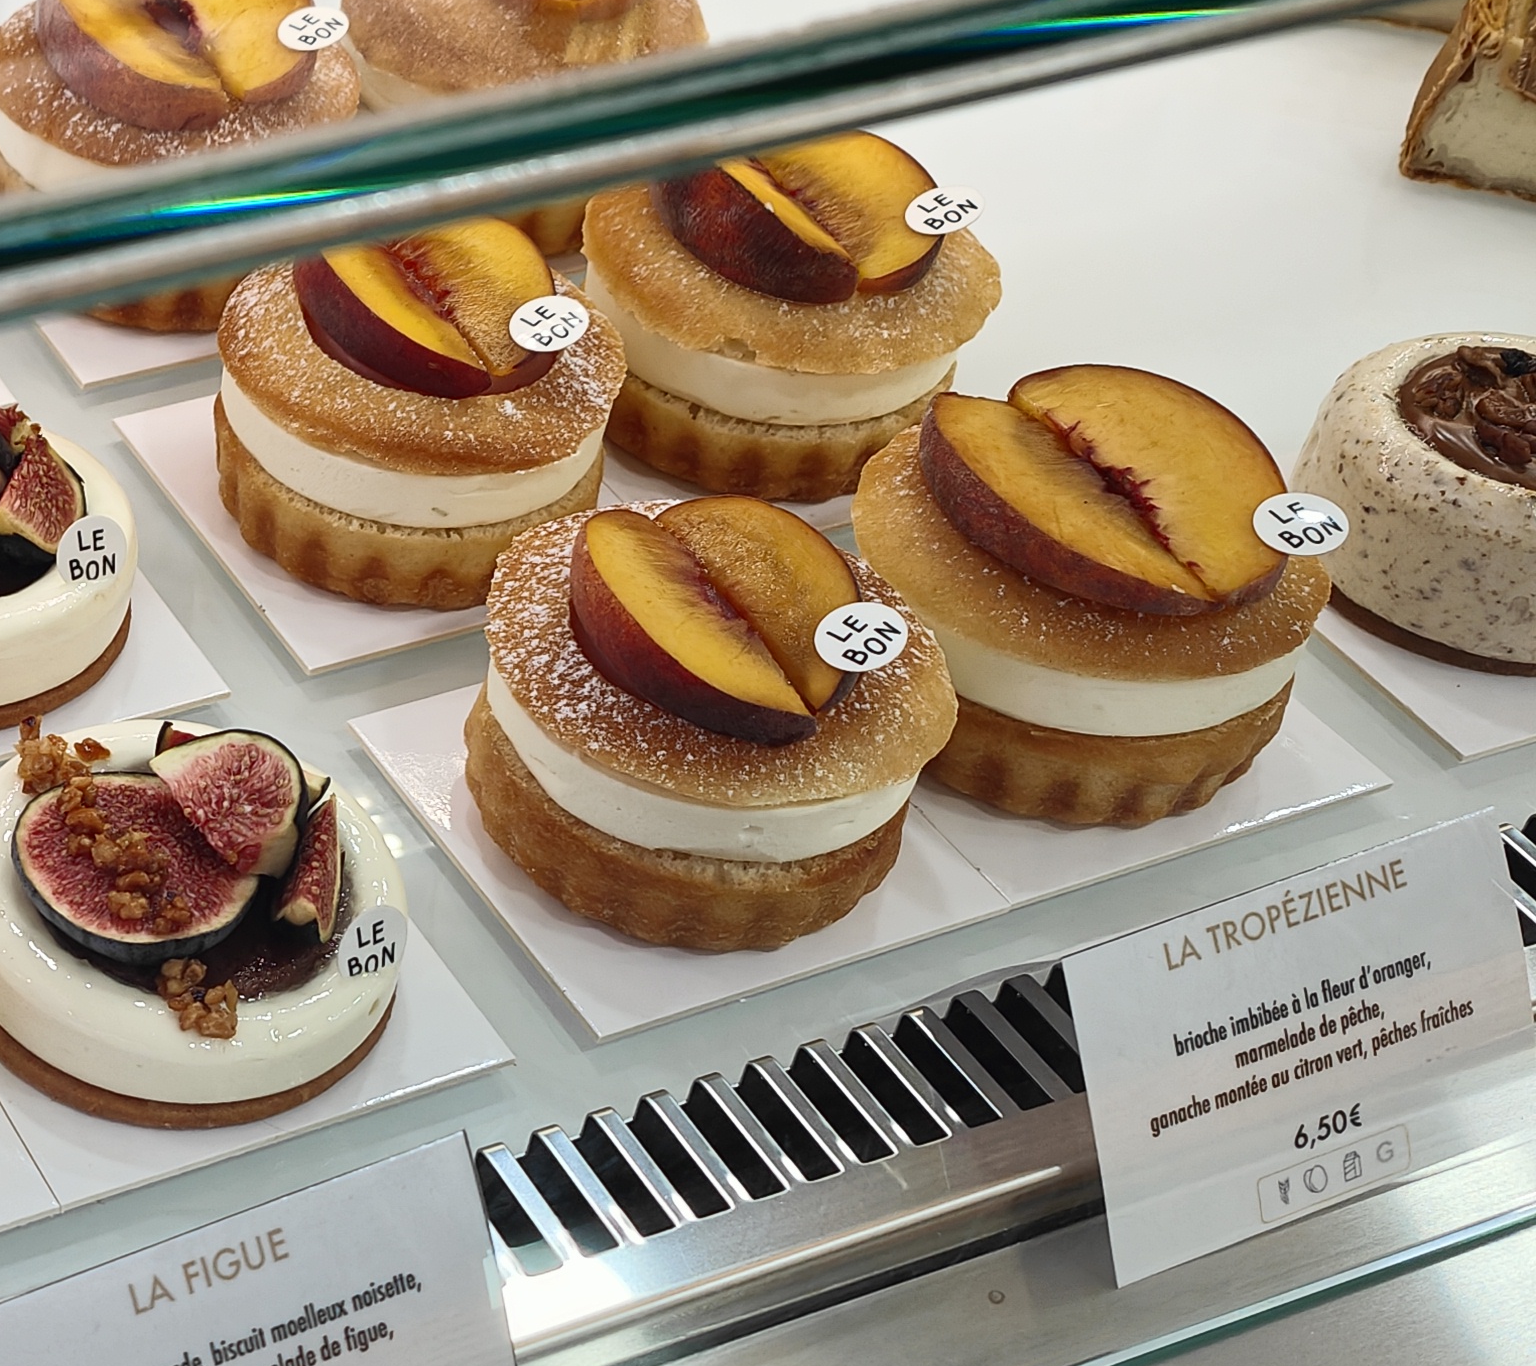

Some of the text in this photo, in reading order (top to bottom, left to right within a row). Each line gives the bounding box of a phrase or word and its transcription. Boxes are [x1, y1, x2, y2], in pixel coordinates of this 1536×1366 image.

[288, 14, 320, 31] LE
[298, 17, 344, 45] BON
[918, 194, 953, 212] LE
[924, 199, 978, 229] BON
[520, 306, 555, 326] LE
[532, 312, 584, 345] BON
[1269, 501, 1305, 524] LE
[77, 529, 104, 551] LE
[1278, 516, 1344, 548] BON
[69, 554, 115, 580] BON
[826, 615, 868, 642] LE
[844, 621, 901, 665] BON
[1162, 858, 1408, 972] LA TROPÉZIENNE
[356, 920, 384, 947] LE
[348, 942, 395, 976] BON
[1173, 952, 1431, 1056] brioche imbibée à la fleur d'oranger,
[1235, 999, 1385, 1069] marmelade de pêche,
[1150, 1000, 1474, 1138] ganache montée au citron vert, pêches fraîches
[1293, 1102, 1362, 1150] 6,50€
[127, 1227, 290, 1316] LA FIGUE
[209, 1328, 266, 1366] biscuit
[270, 1300, 348, 1343] moelleux
[351, 1273, 421, 1312] noisette,
[319, 1335, 342, 1361] de
[344, 1322, 394, 1353] figue,
